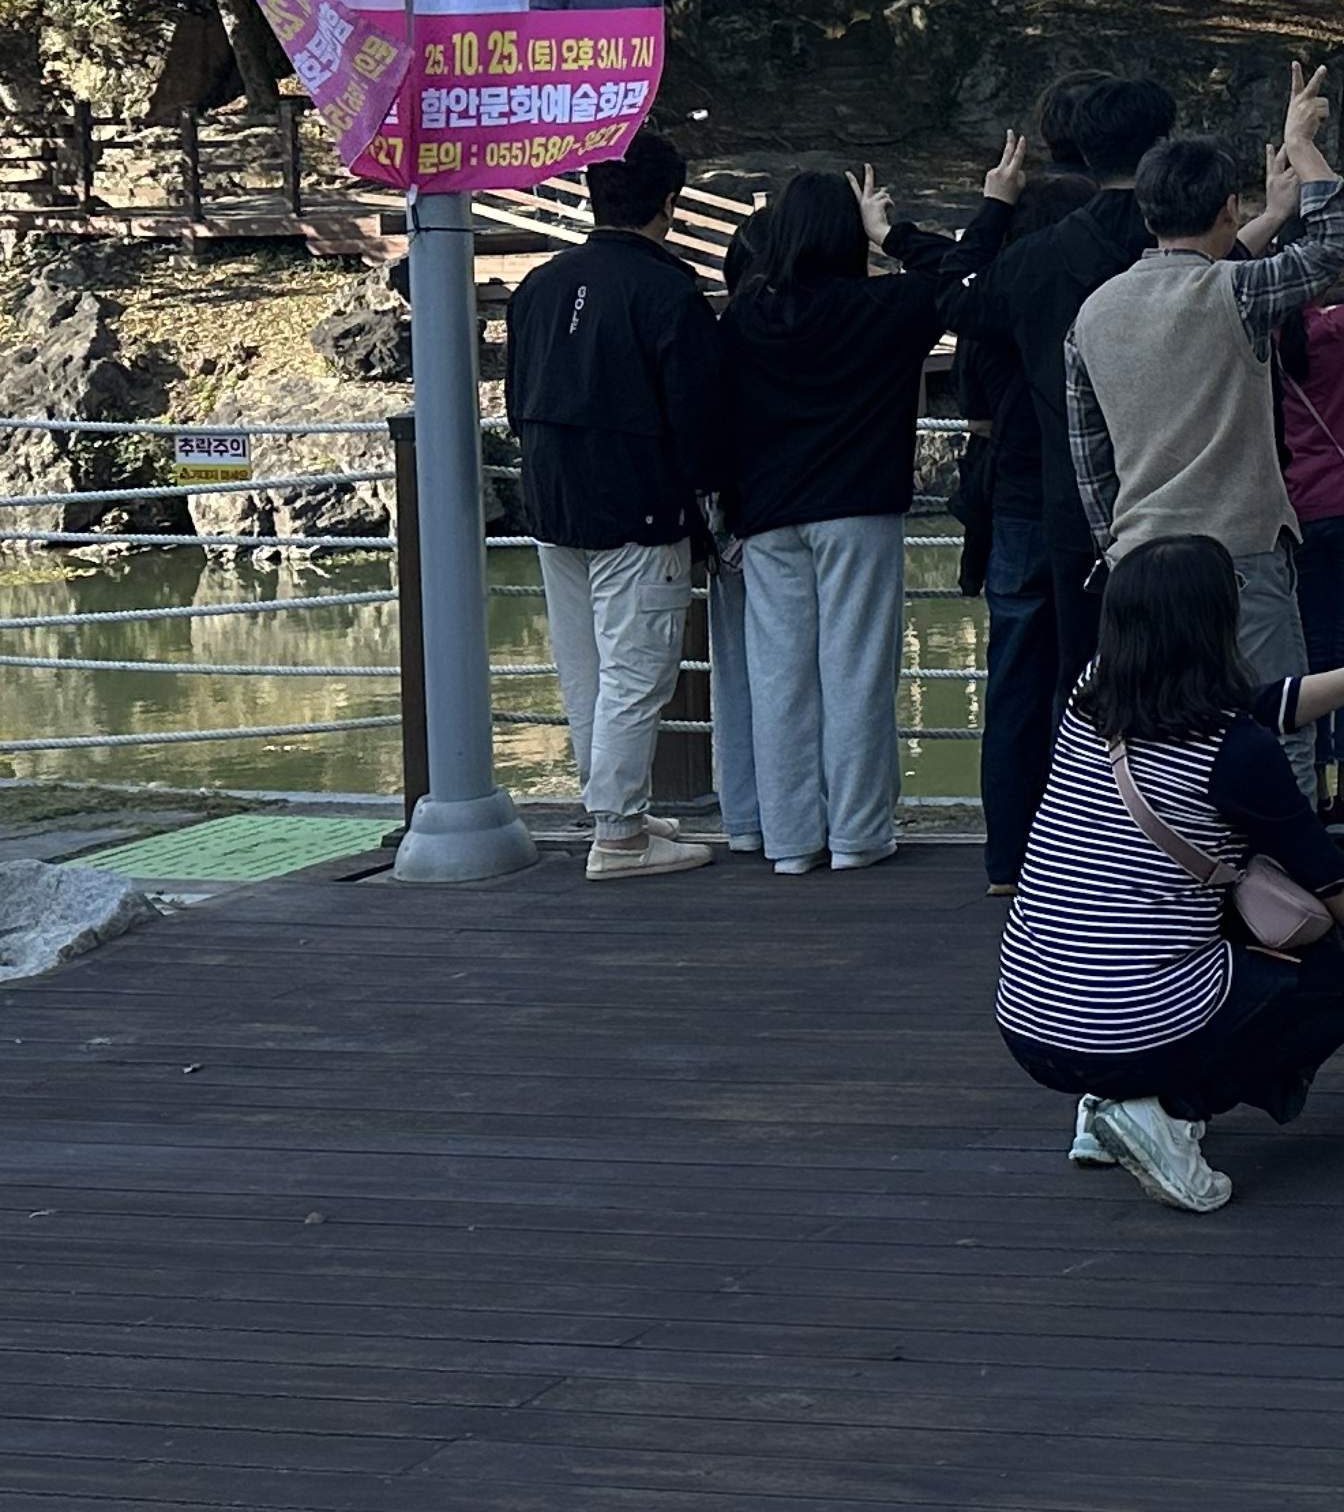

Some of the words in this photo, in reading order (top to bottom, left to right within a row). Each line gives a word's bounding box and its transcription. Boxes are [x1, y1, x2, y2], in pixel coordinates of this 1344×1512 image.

[452, 31, 484, 76] 10.
[488, 31, 523, 75] 25.
[527, 39, 558, 72] (토)
[561, 38, 595, 71] 오후
[630, 36, 655, 68] 7시
[421, 80, 650, 128] 함안문화예술회관
[418, 141, 462, 174] 문의
[178, 437, 247, 458] 추락주의
